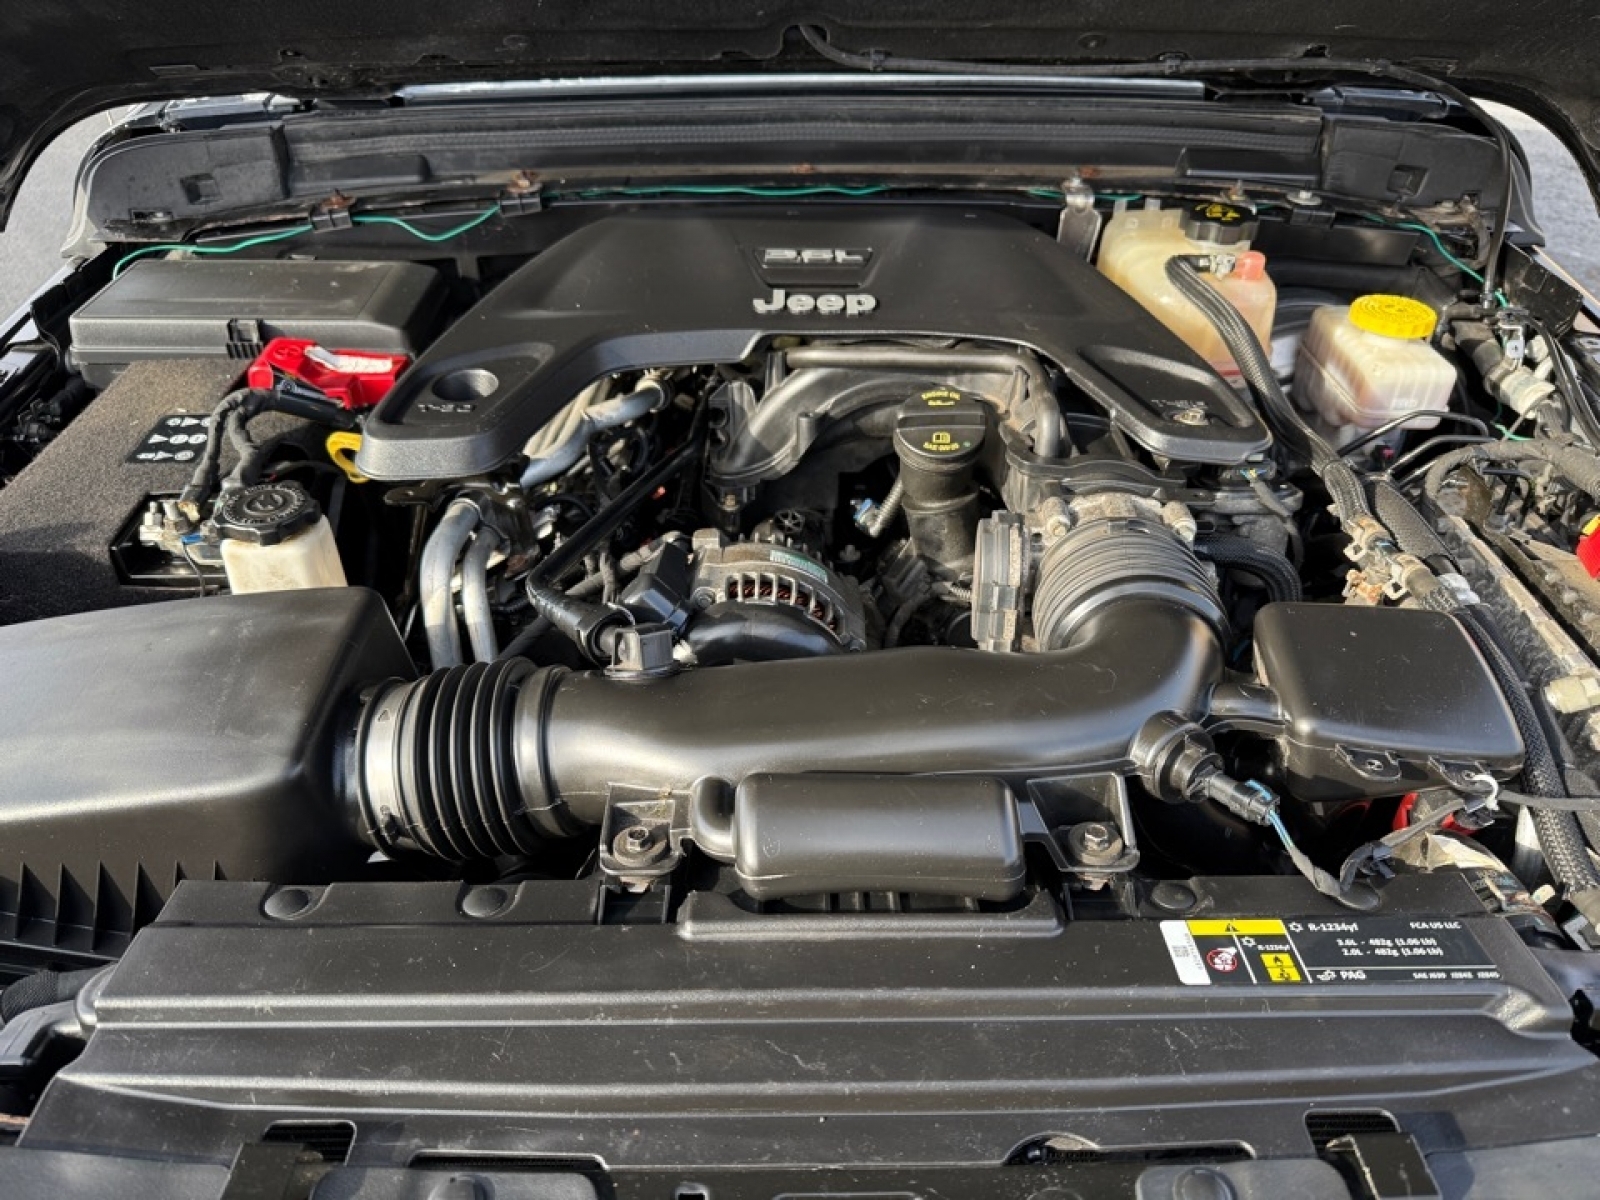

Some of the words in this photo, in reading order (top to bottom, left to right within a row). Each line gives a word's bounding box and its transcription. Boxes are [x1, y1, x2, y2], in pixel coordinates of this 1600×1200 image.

[752, 289, 877, 317] Jeep
[1308, 922, 1359, 933] R-1234yf
[1339, 970, 1367, 979] PAG
